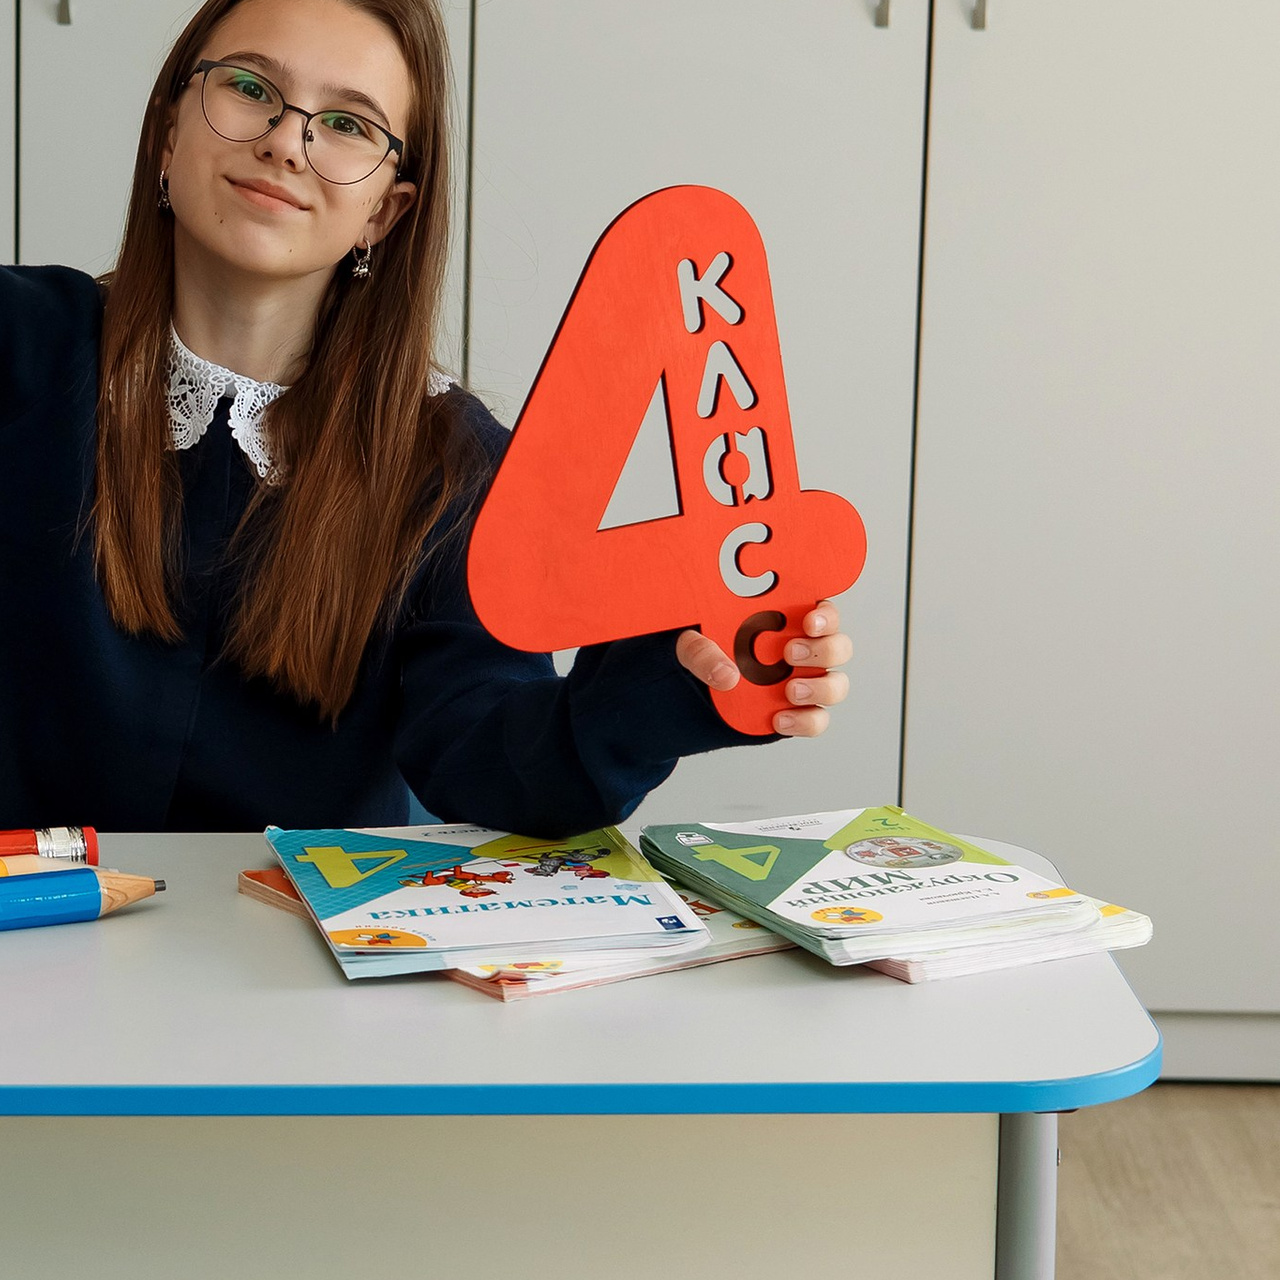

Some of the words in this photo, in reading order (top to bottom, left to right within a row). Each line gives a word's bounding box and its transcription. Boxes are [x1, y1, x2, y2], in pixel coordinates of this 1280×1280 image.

[467, 183, 868, 736] 4
[295, 846, 408, 888] 4
[691, 844, 781, 881] 4
[785, 872, 1020, 908] Окружающий
[802, 870, 920, 895] МИР
[369, 893, 657, 921] Математика
